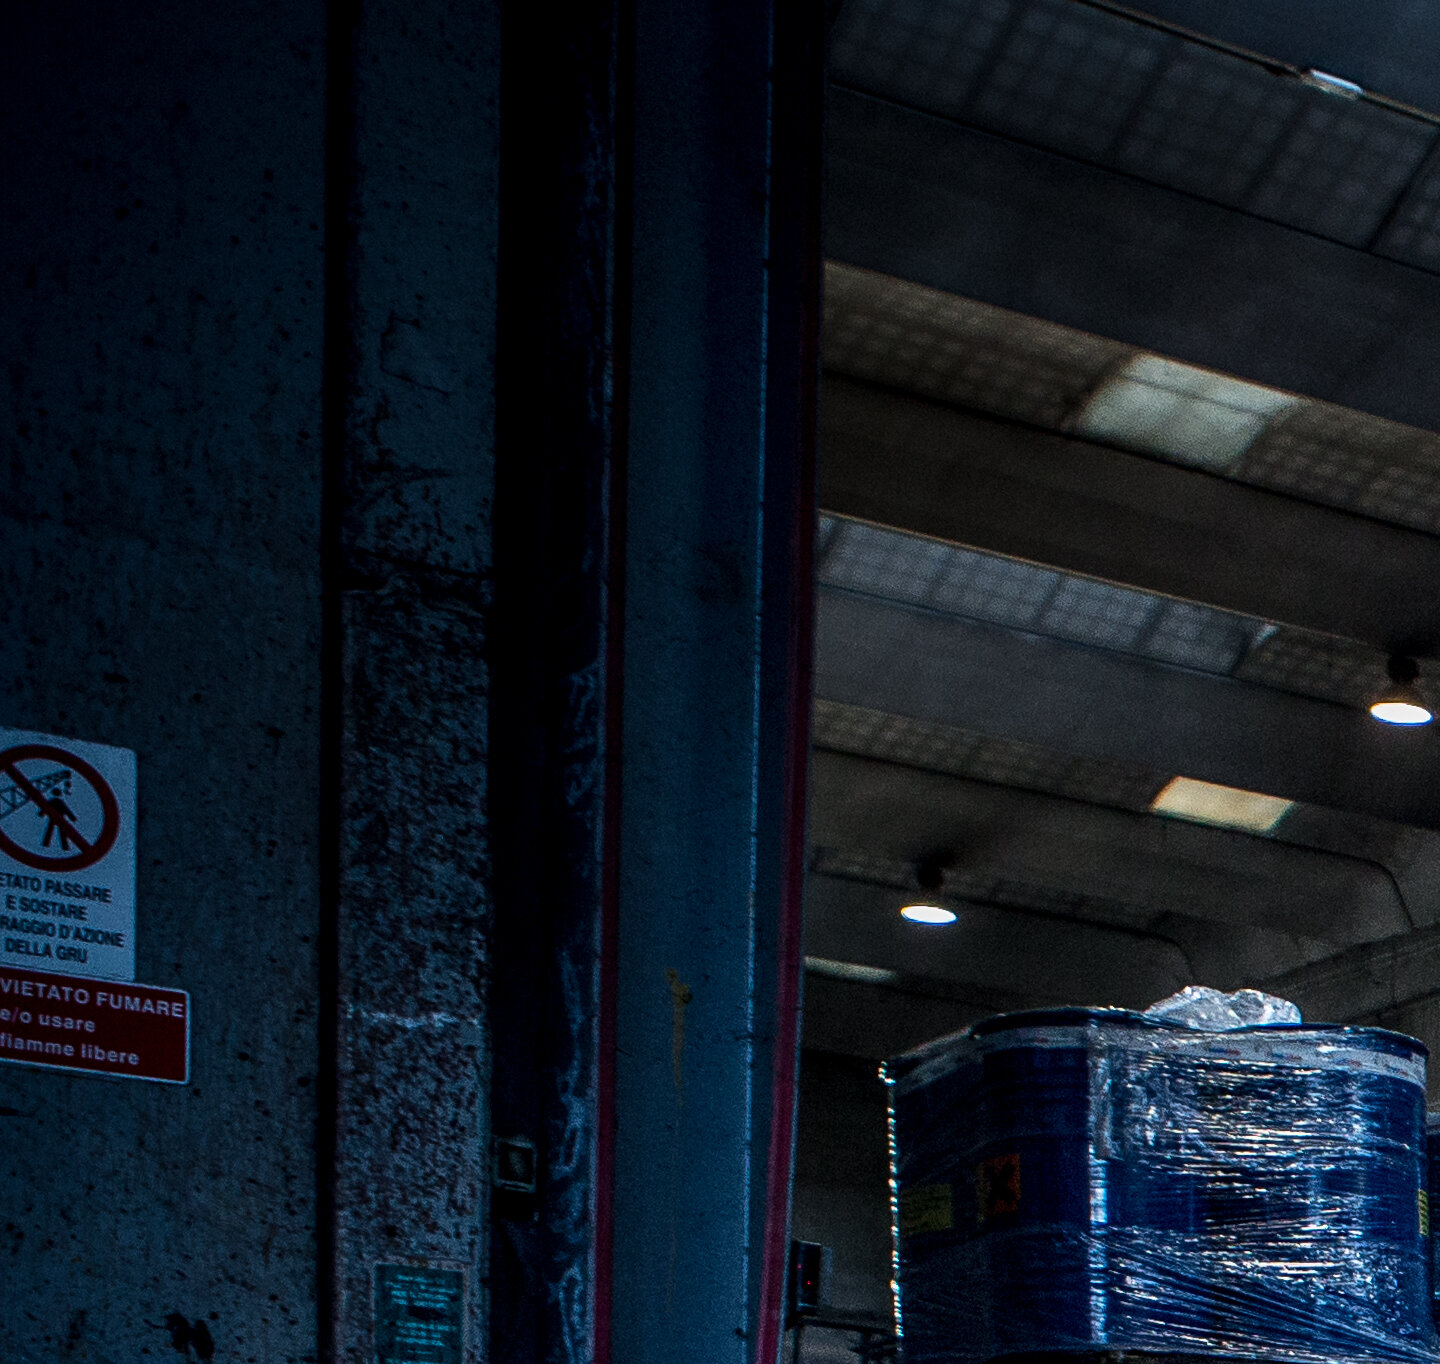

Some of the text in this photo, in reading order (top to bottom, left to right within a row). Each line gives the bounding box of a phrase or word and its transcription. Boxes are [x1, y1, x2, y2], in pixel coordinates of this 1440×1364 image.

[44, 878, 113, 904] PASSARE
[6, 894, 88, 921] E SOSTARE
[58, 923, 125, 948] D'AZIONE
[4, 936, 88, 964] DELLA GRU
[0, 976, 185, 1018] VIETATO FUMARE
[0, 1006, 97, 1033] e/o usare
[0, 1032, 141, 1067] fiamme libere
